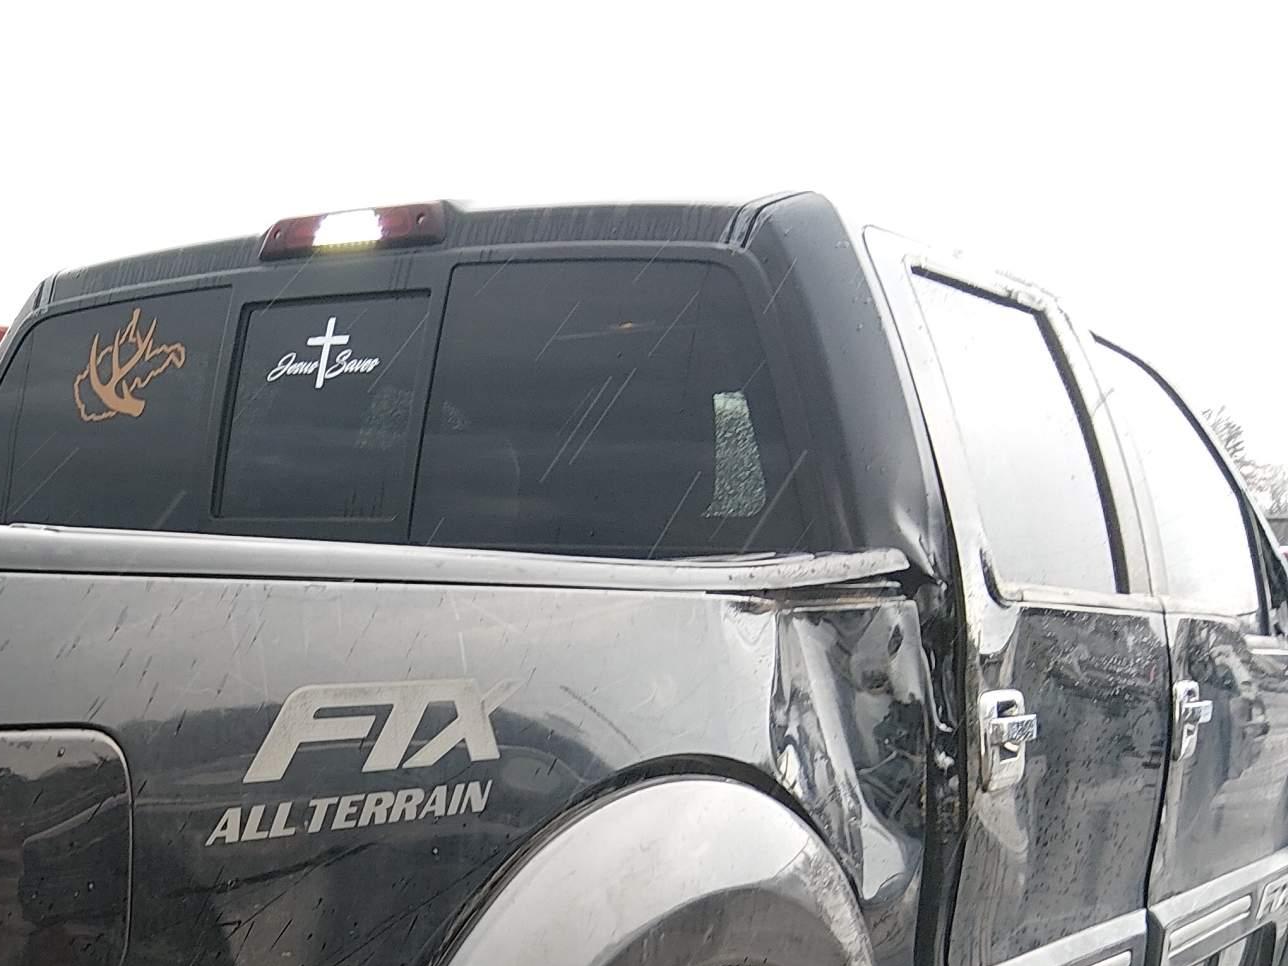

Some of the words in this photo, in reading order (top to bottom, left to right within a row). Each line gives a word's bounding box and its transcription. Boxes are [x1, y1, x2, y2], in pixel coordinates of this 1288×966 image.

[267, 351, 320, 382] Jesus
[324, 348, 380, 380] Saves
[242, 678, 527, 784] FTX
[204, 800, 297, 848] ALL
[303, 779, 494, 835] TERRAIN
